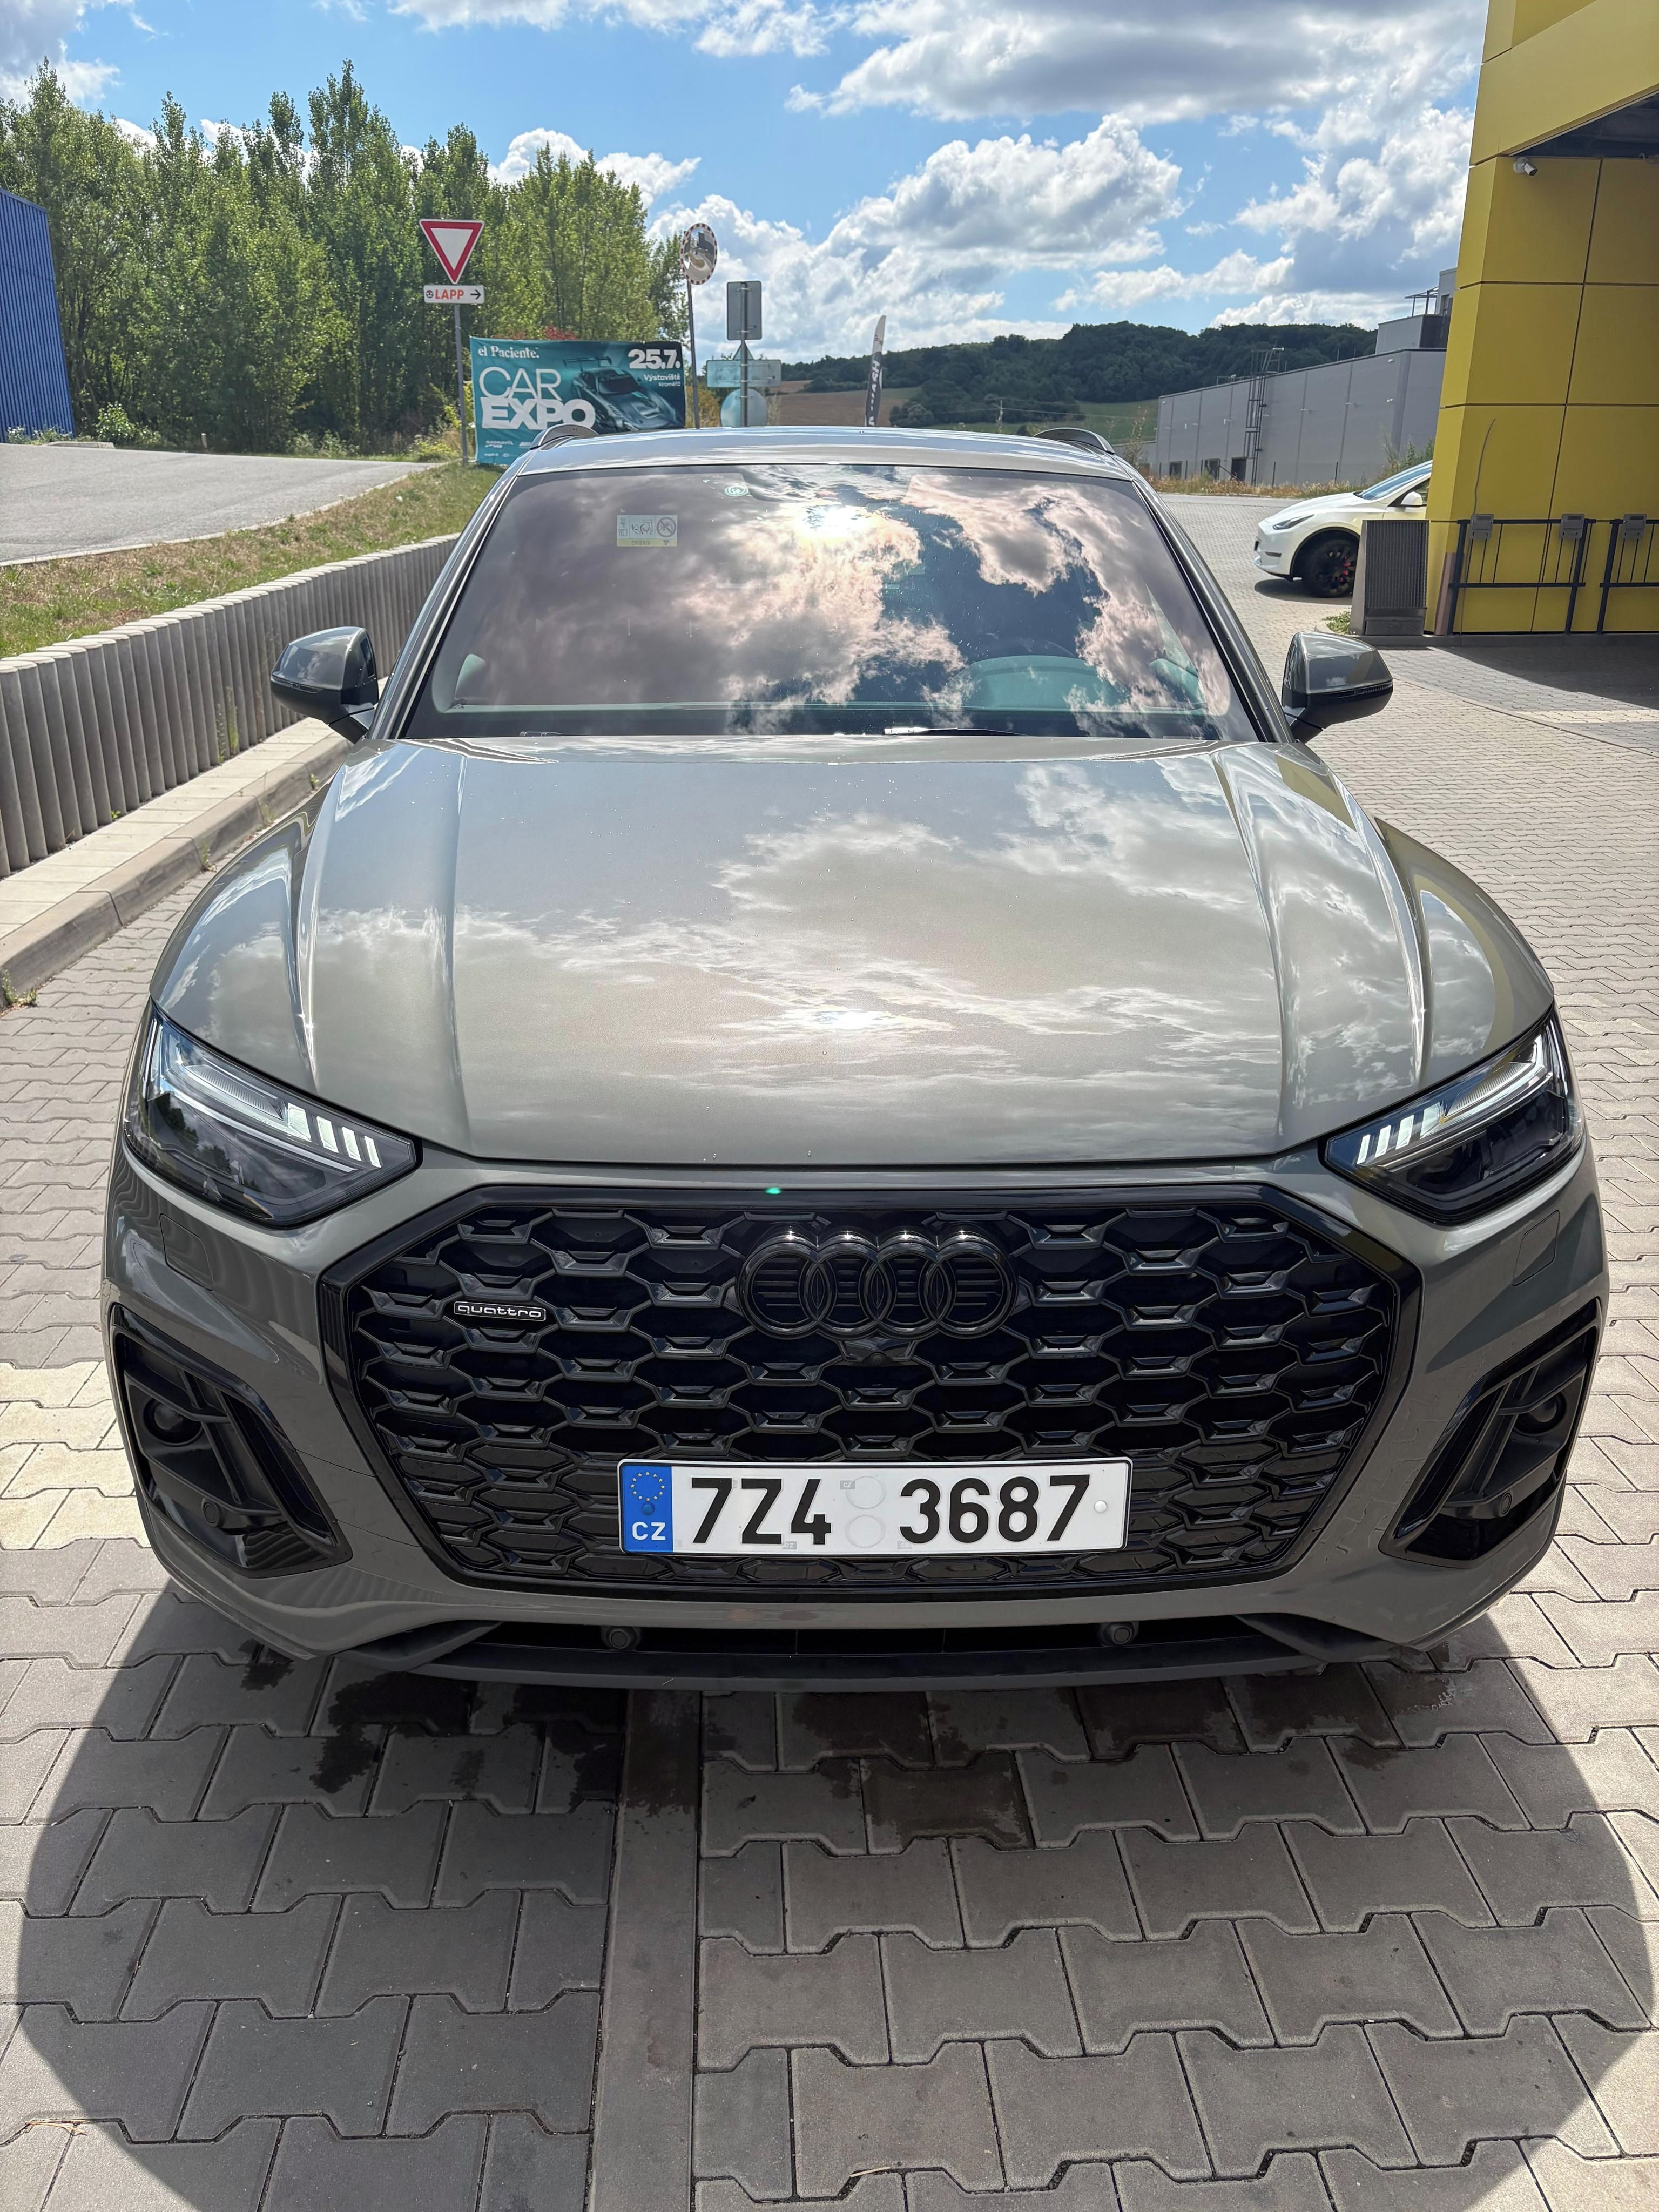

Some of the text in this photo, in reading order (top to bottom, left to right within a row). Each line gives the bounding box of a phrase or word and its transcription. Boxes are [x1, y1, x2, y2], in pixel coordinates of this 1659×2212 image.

[435, 289, 464, 300] LAPP
[478, 346, 488, 356] el
[628, 349, 680, 369] 25.7.
[479, 366, 563, 401] CAR
[480, 397, 596, 430] EXPO
[458, 1305, 541, 1318] quattro
[691, 1474, 1090, 1545] 7Z4 3687
[632, 1521, 666, 1541] CZ
